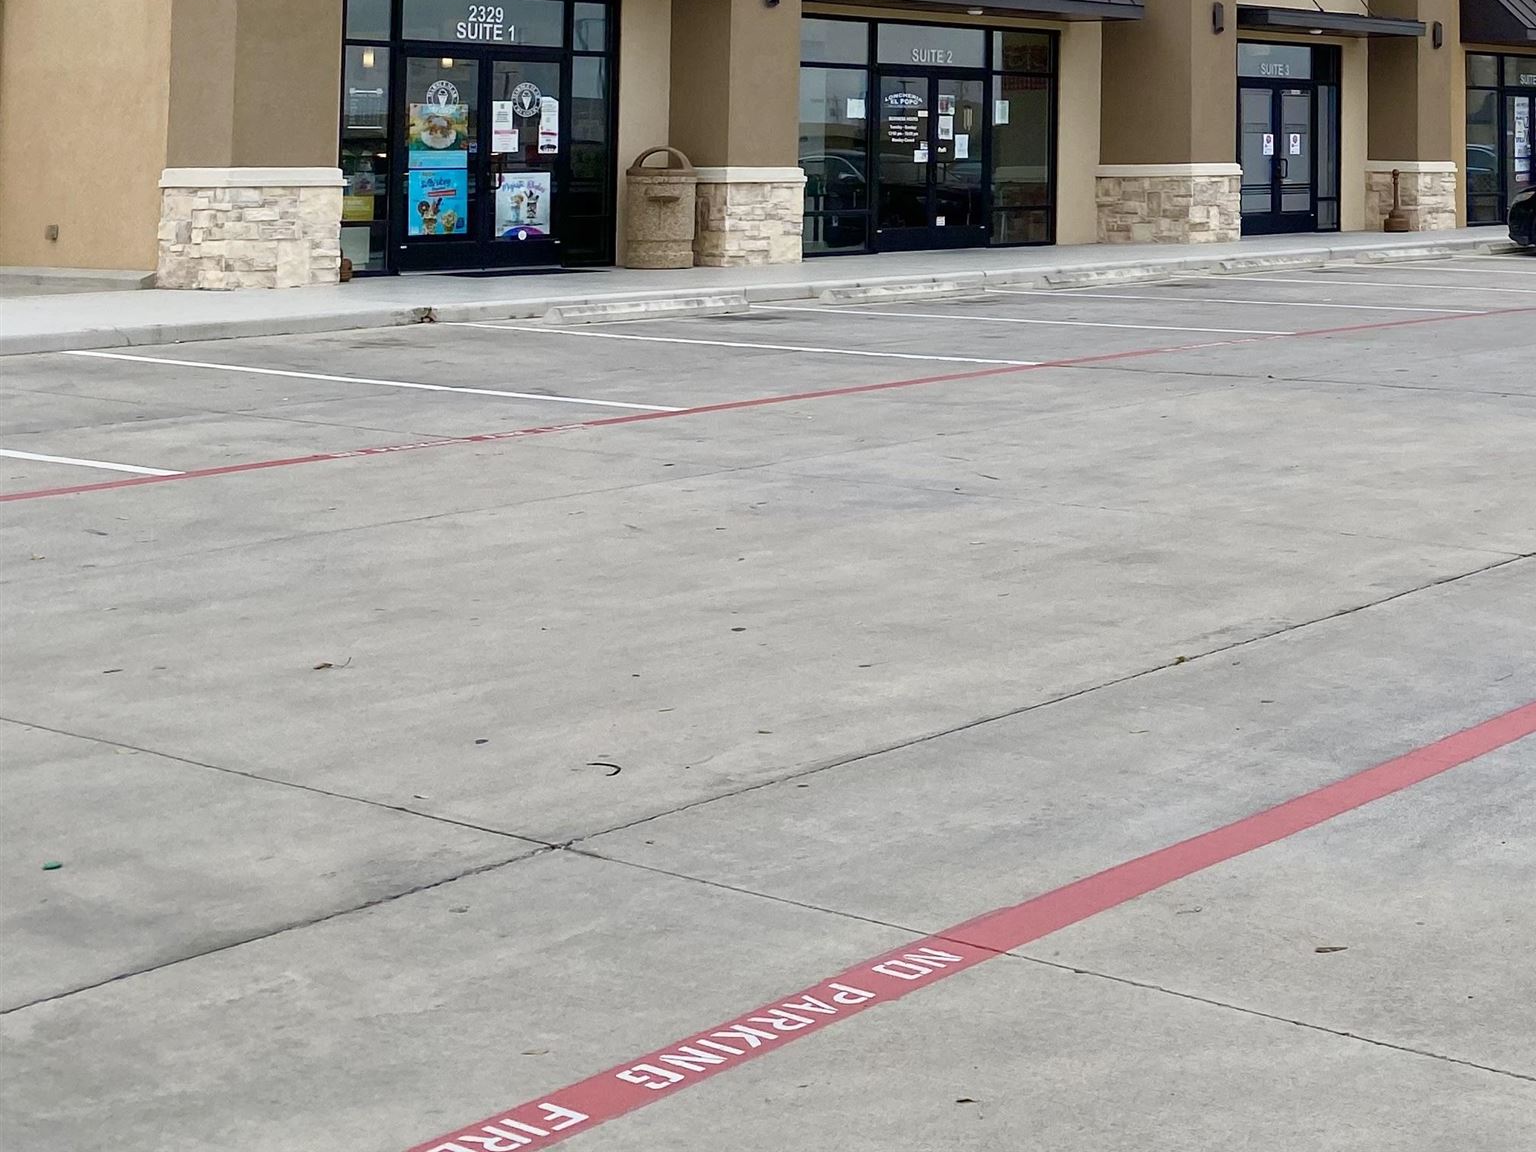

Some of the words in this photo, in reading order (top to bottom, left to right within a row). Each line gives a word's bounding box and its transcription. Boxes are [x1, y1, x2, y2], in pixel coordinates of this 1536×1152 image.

[468, 5, 504, 23] 2329
[456, 22, 503, 41] SUITE
[508, 25, 515, 42] 1
[912, 48, 944, 64] SUITE
[946, 50, 953, 64] 2
[1260, 63, 1284, 76] SUITE
[1520, 74, 1536, 85] SUITE
[872, 947, 963, 980] NO
[615, 982, 877, 1090] PARKING
